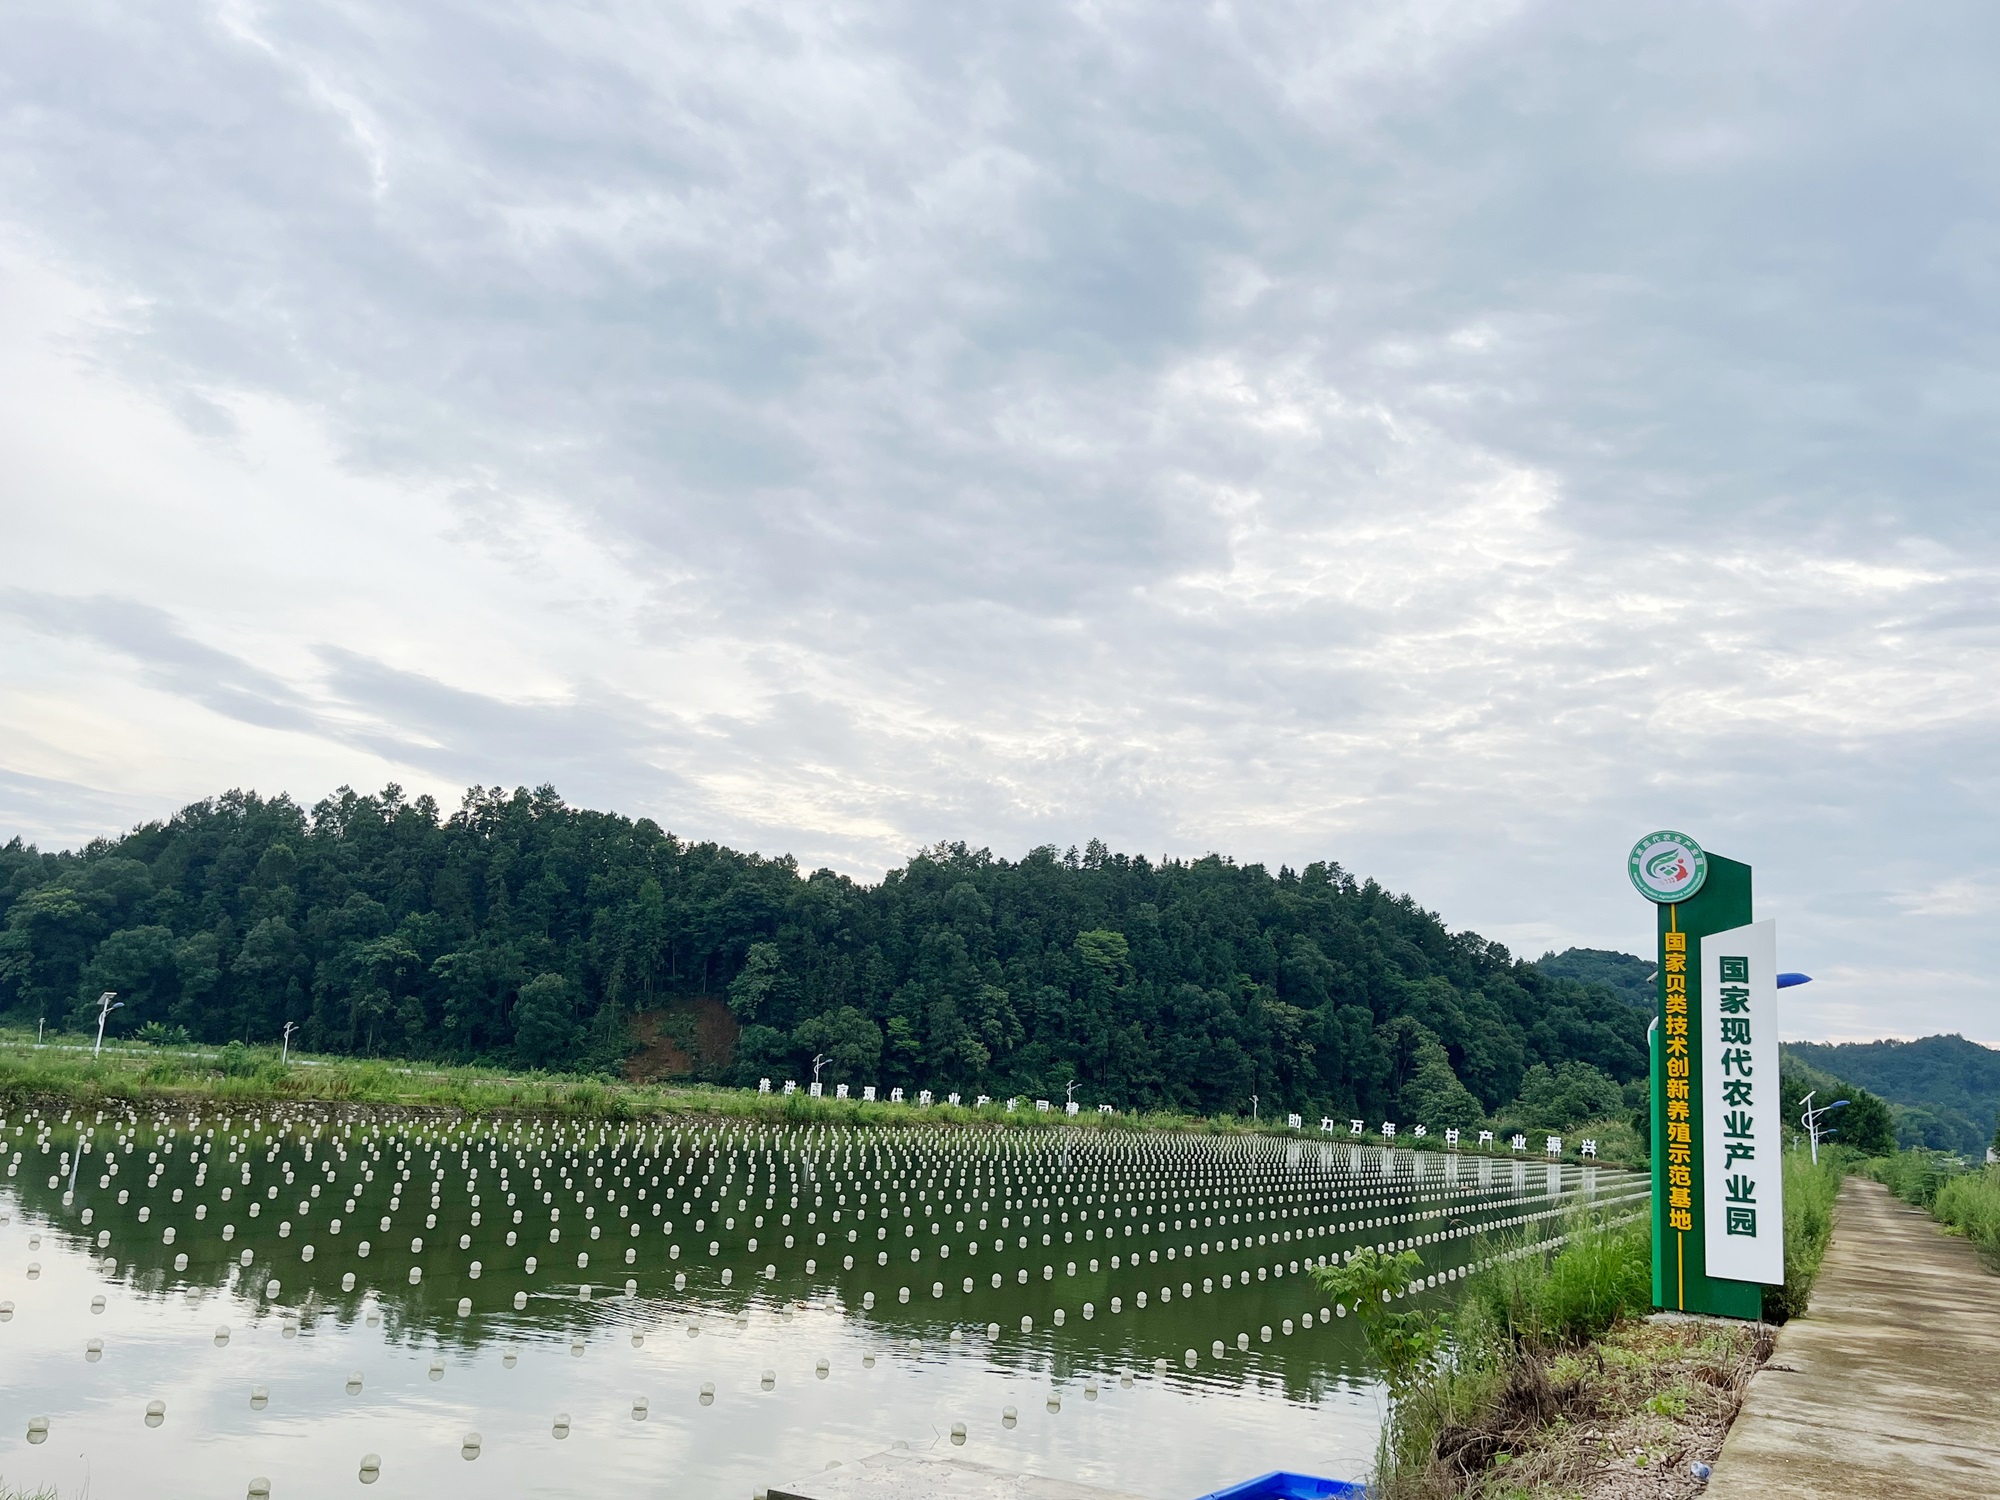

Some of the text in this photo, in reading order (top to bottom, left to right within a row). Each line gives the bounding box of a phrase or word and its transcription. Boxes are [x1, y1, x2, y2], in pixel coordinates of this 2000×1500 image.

[1288, 1113, 1597, 1155] 助力万年乡村产业振兴
[1665, 932, 1692, 1231] 国家贝类技术创新养殖示范基地
[1719, 956, 1757, 1238] 国家现代农业产业园
